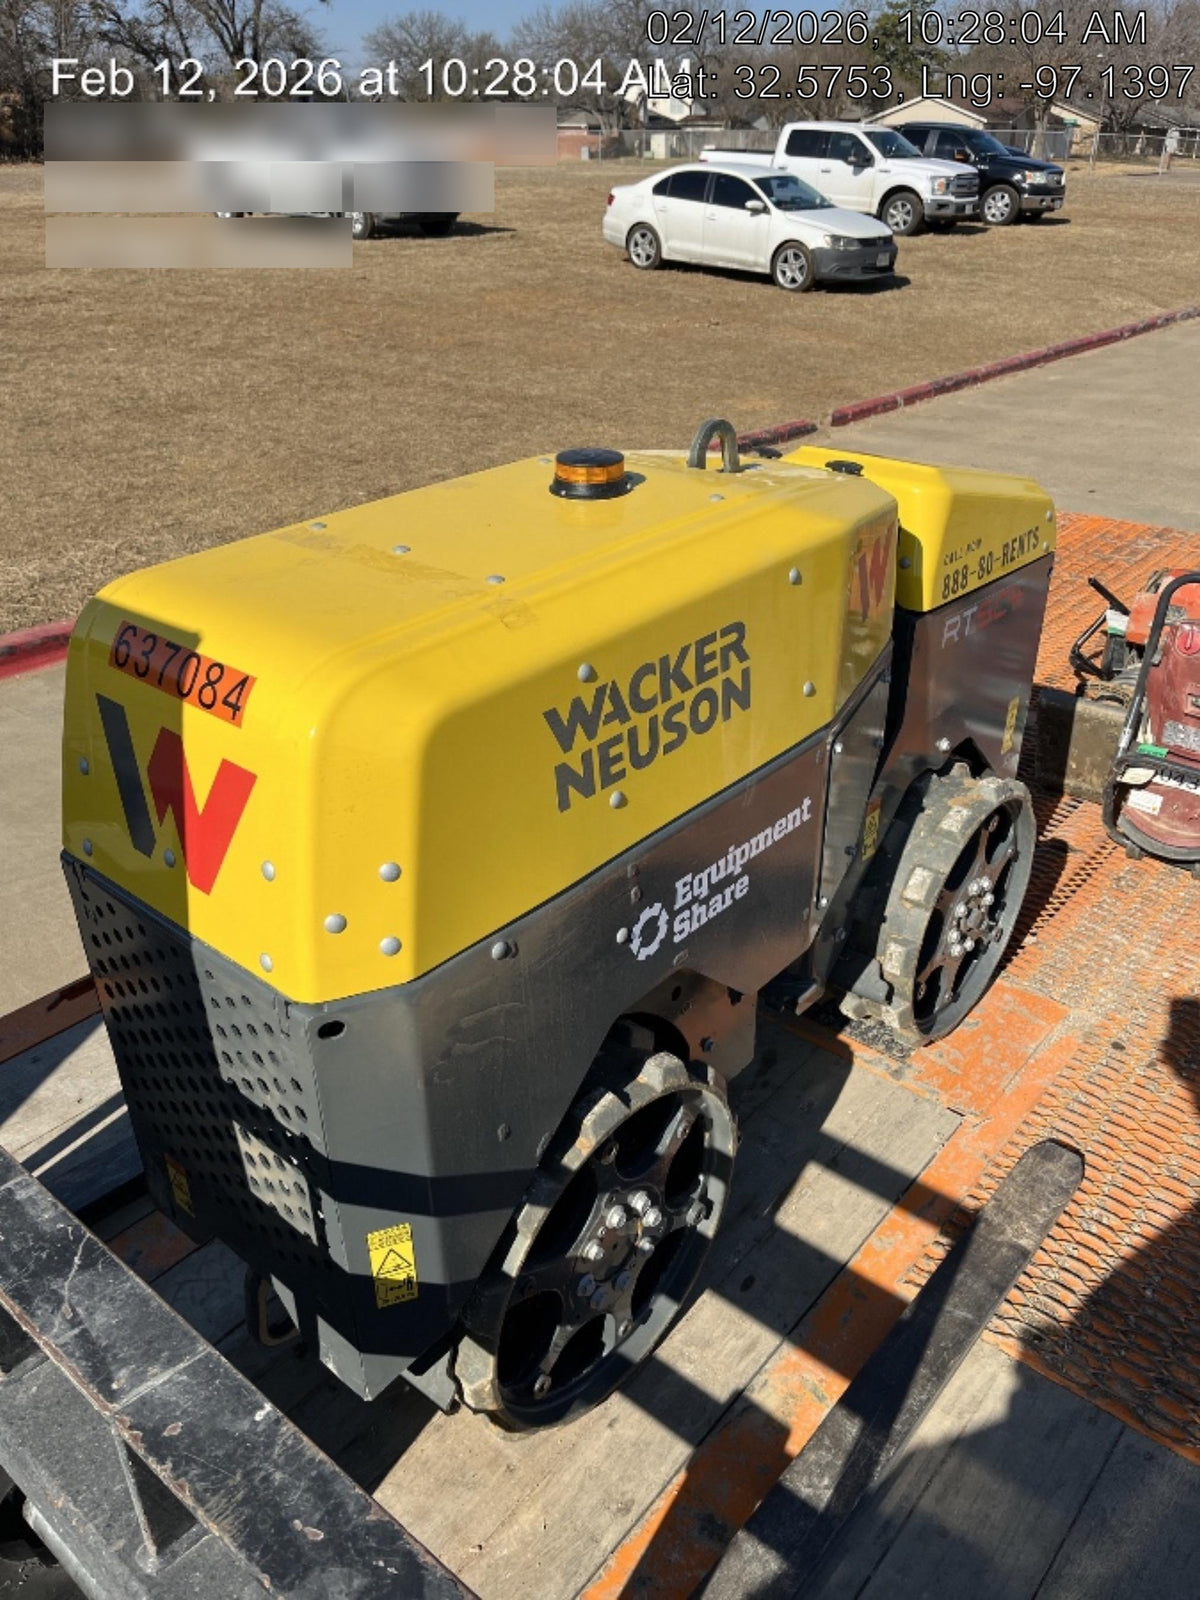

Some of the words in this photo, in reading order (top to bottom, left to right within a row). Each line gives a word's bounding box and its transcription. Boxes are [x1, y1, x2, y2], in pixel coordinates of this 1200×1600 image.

[941, 525, 1040, 600] 888-80-RENTS
[113, 624, 250, 721] 637084
[542, 620, 751, 754] WACKER
[553, 665, 752, 814] NEUSON
[673, 795, 813, 911] Equipment
[672, 873, 750, 944] Share
